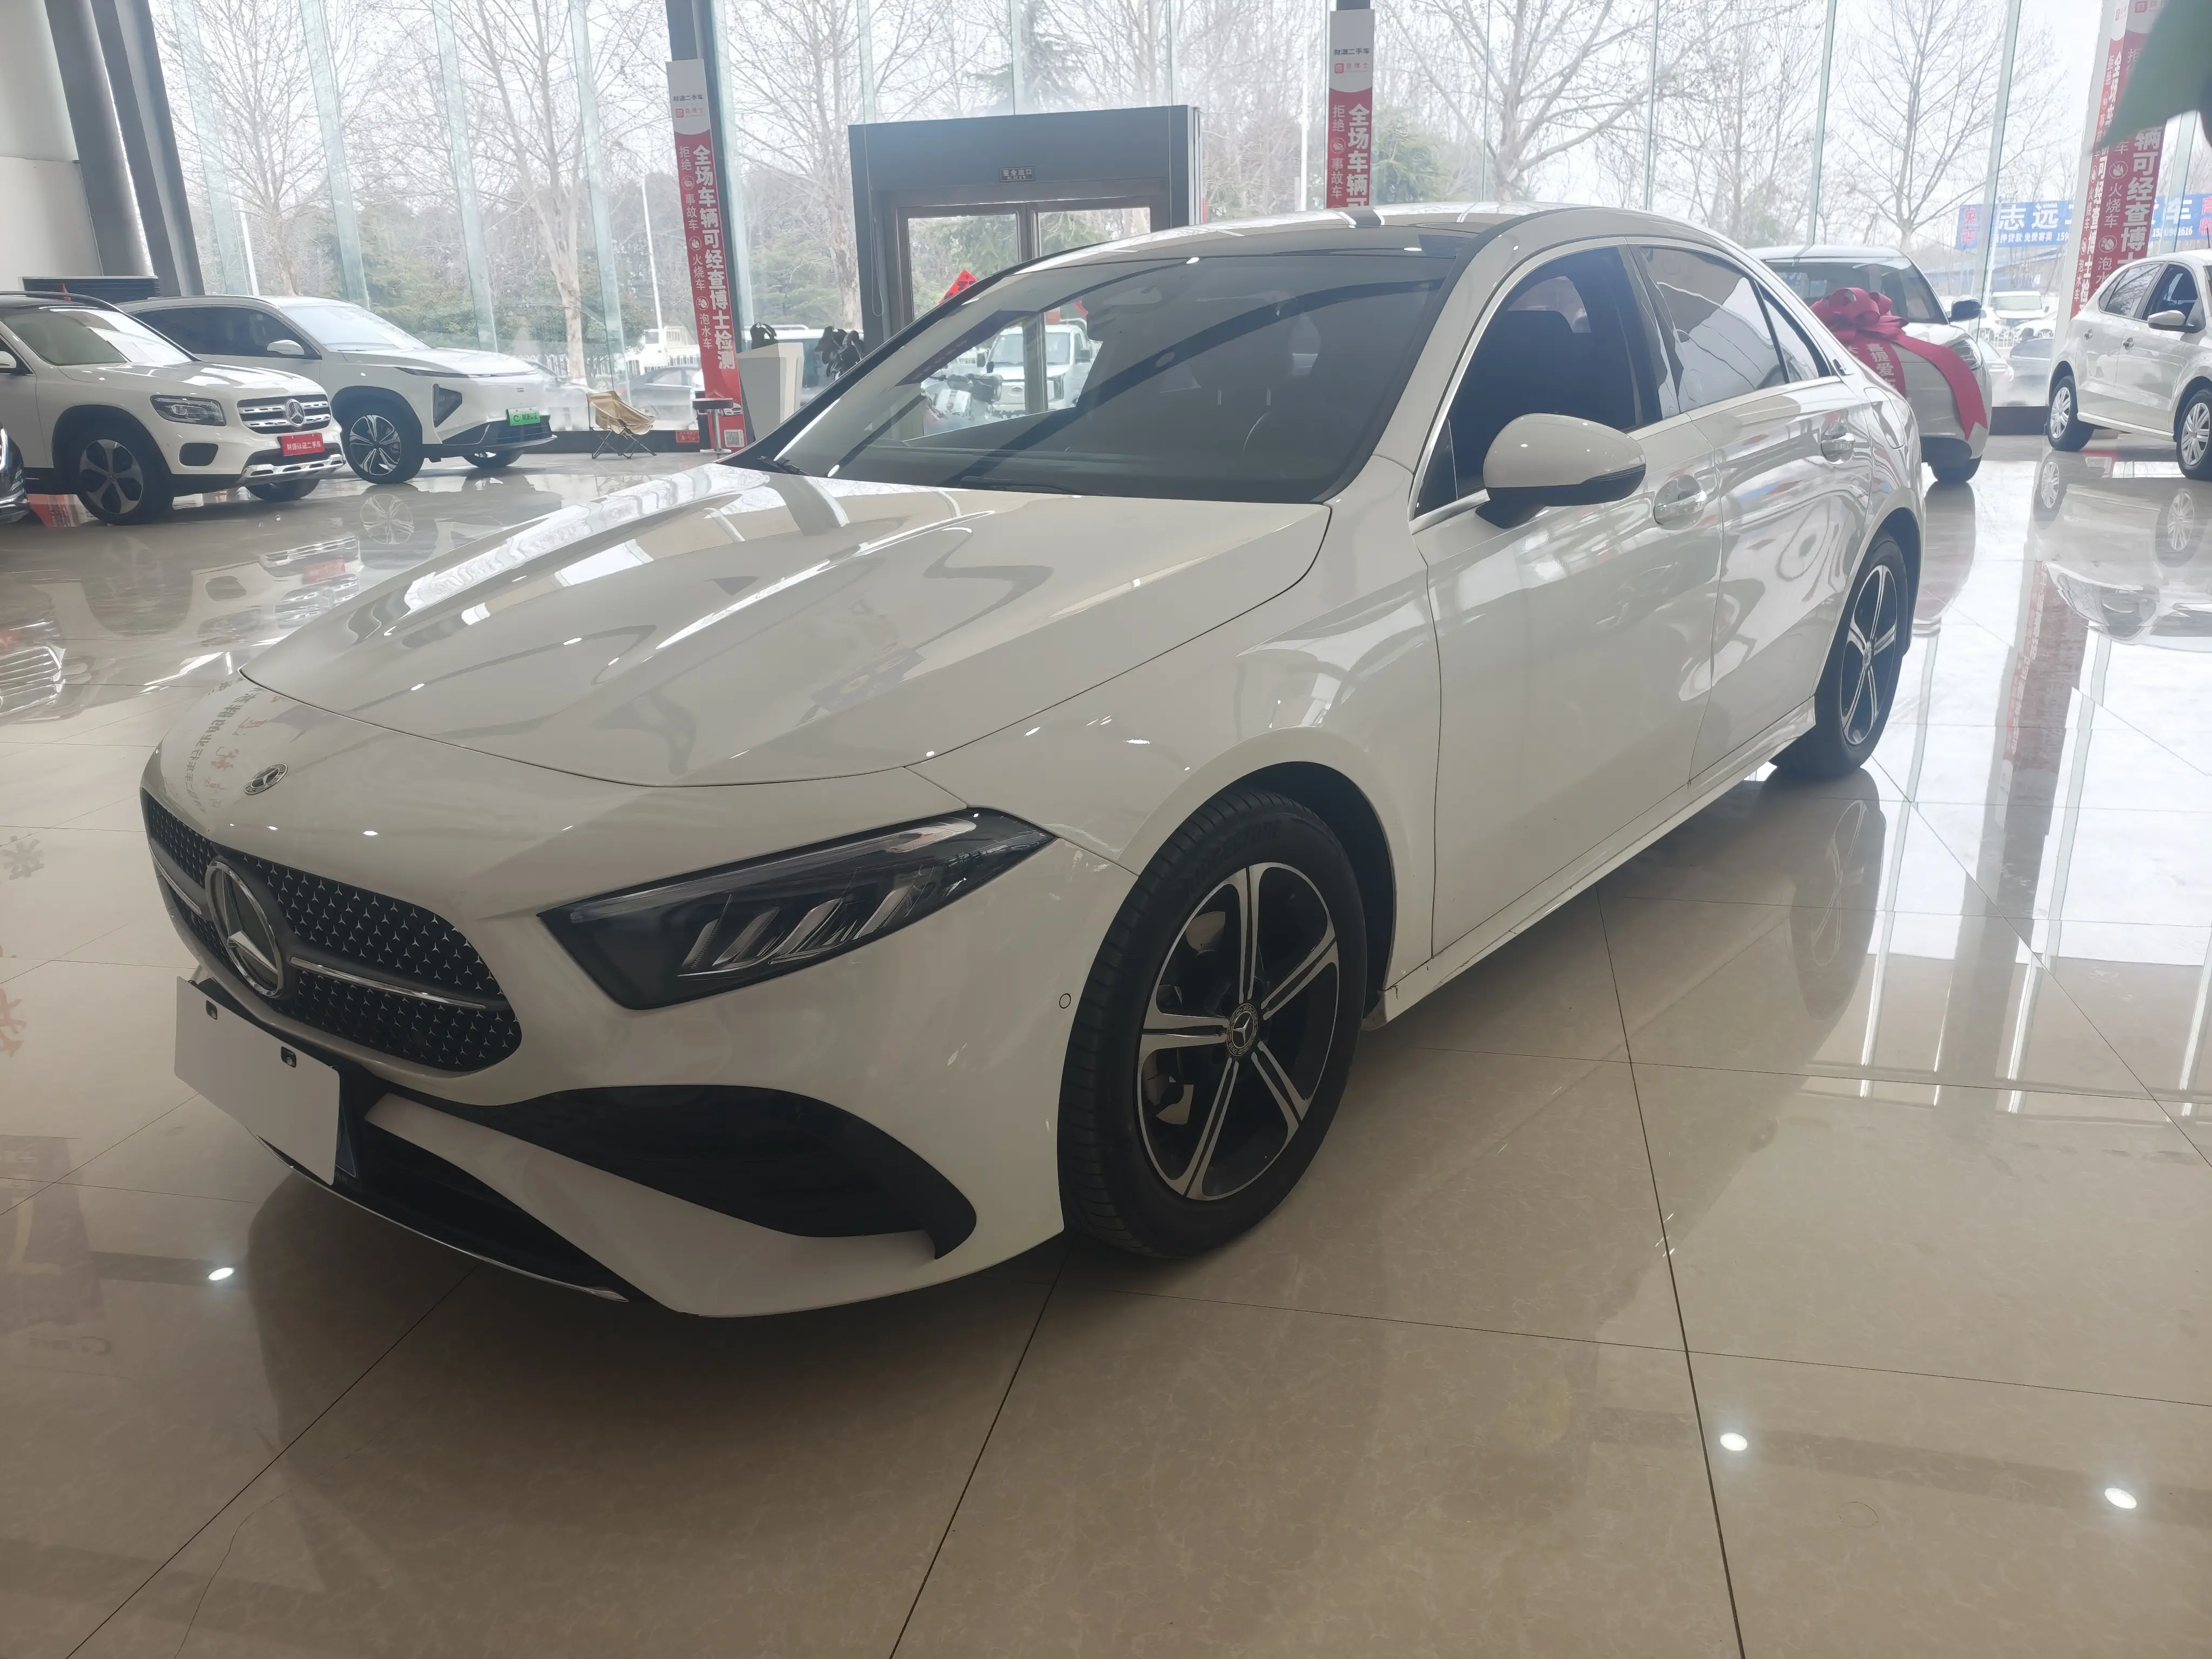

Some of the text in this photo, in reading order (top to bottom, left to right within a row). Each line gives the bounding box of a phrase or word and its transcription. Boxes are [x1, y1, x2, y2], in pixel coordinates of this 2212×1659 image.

[1330, 105, 1345, 199] 拒绝 事故车
[2103, 182, 2123, 229] 火烧车
[679, 146, 713, 349] 拒绝 事故车 火烧车 泡水车
[692, 144, 736, 370] 全场车辆可经查博士检测
